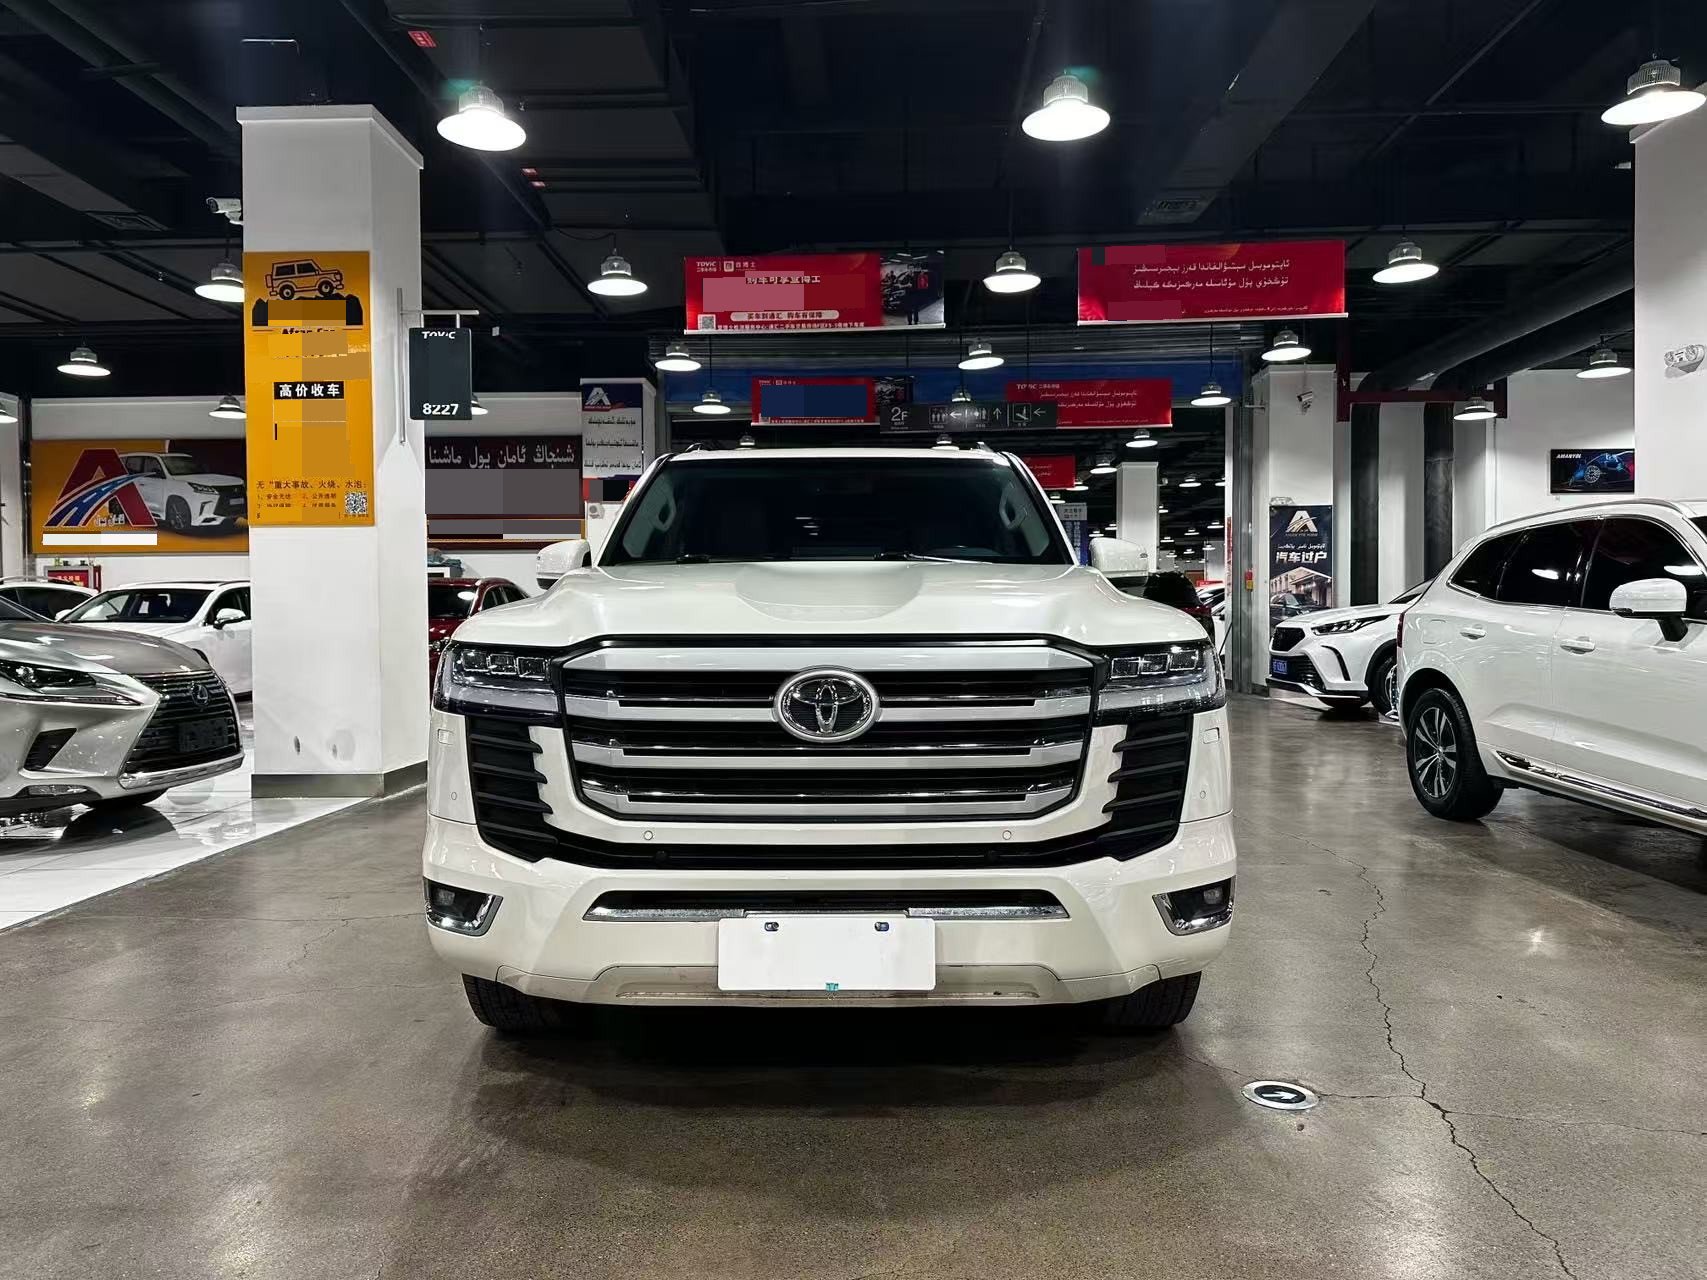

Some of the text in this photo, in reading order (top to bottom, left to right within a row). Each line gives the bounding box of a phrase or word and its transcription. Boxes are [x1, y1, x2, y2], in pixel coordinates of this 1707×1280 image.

[279, 384, 341, 398] 高价收车
[422, 402, 459, 415] 8227
[891, 406, 908, 421] 2F
[469, 445, 490, 469] يول
[1276, 551, 1328, 564] 汽车过户
